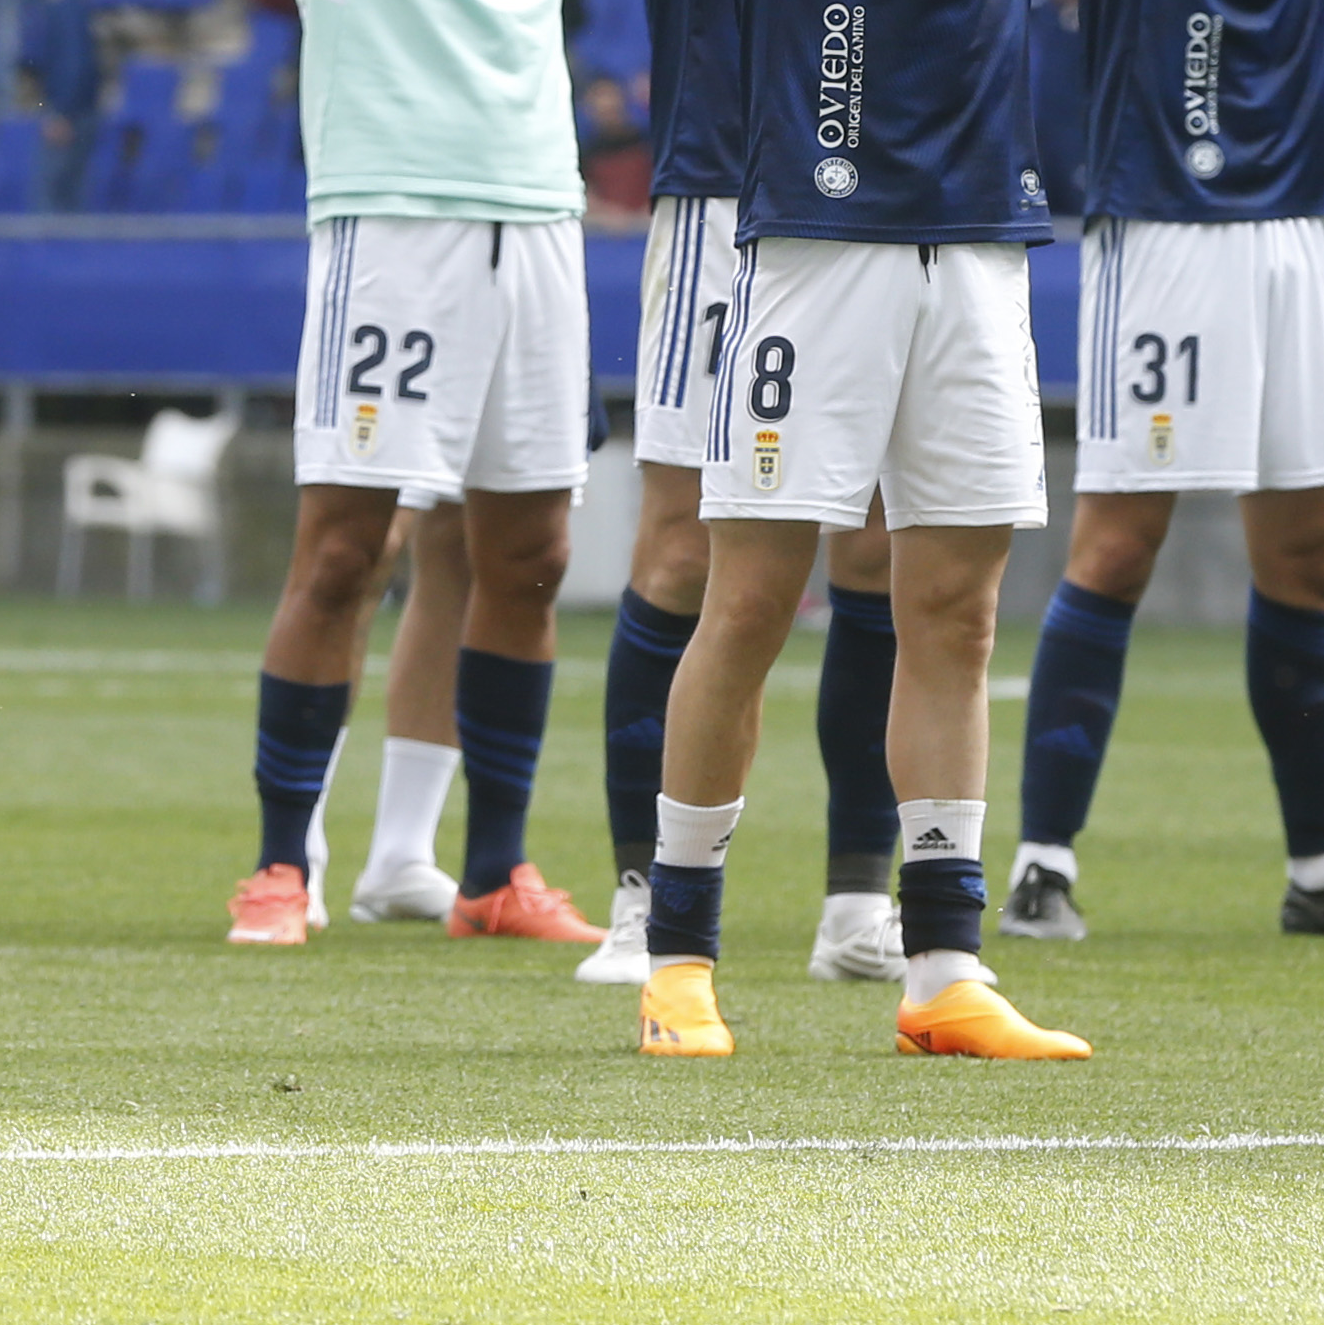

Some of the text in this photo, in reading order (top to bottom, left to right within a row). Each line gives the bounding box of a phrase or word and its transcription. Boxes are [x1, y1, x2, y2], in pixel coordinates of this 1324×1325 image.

[817, 3, 850, 149] OVIEDO
[847, 5, 865, 149] ORIGEN DEL CAMINO
[1183, 12, 1212, 136] OVIEDO
[346, 324, 434, 403] 22
[747, 335, 796, 423] 8
[1130, 333, 1198, 405] 31
